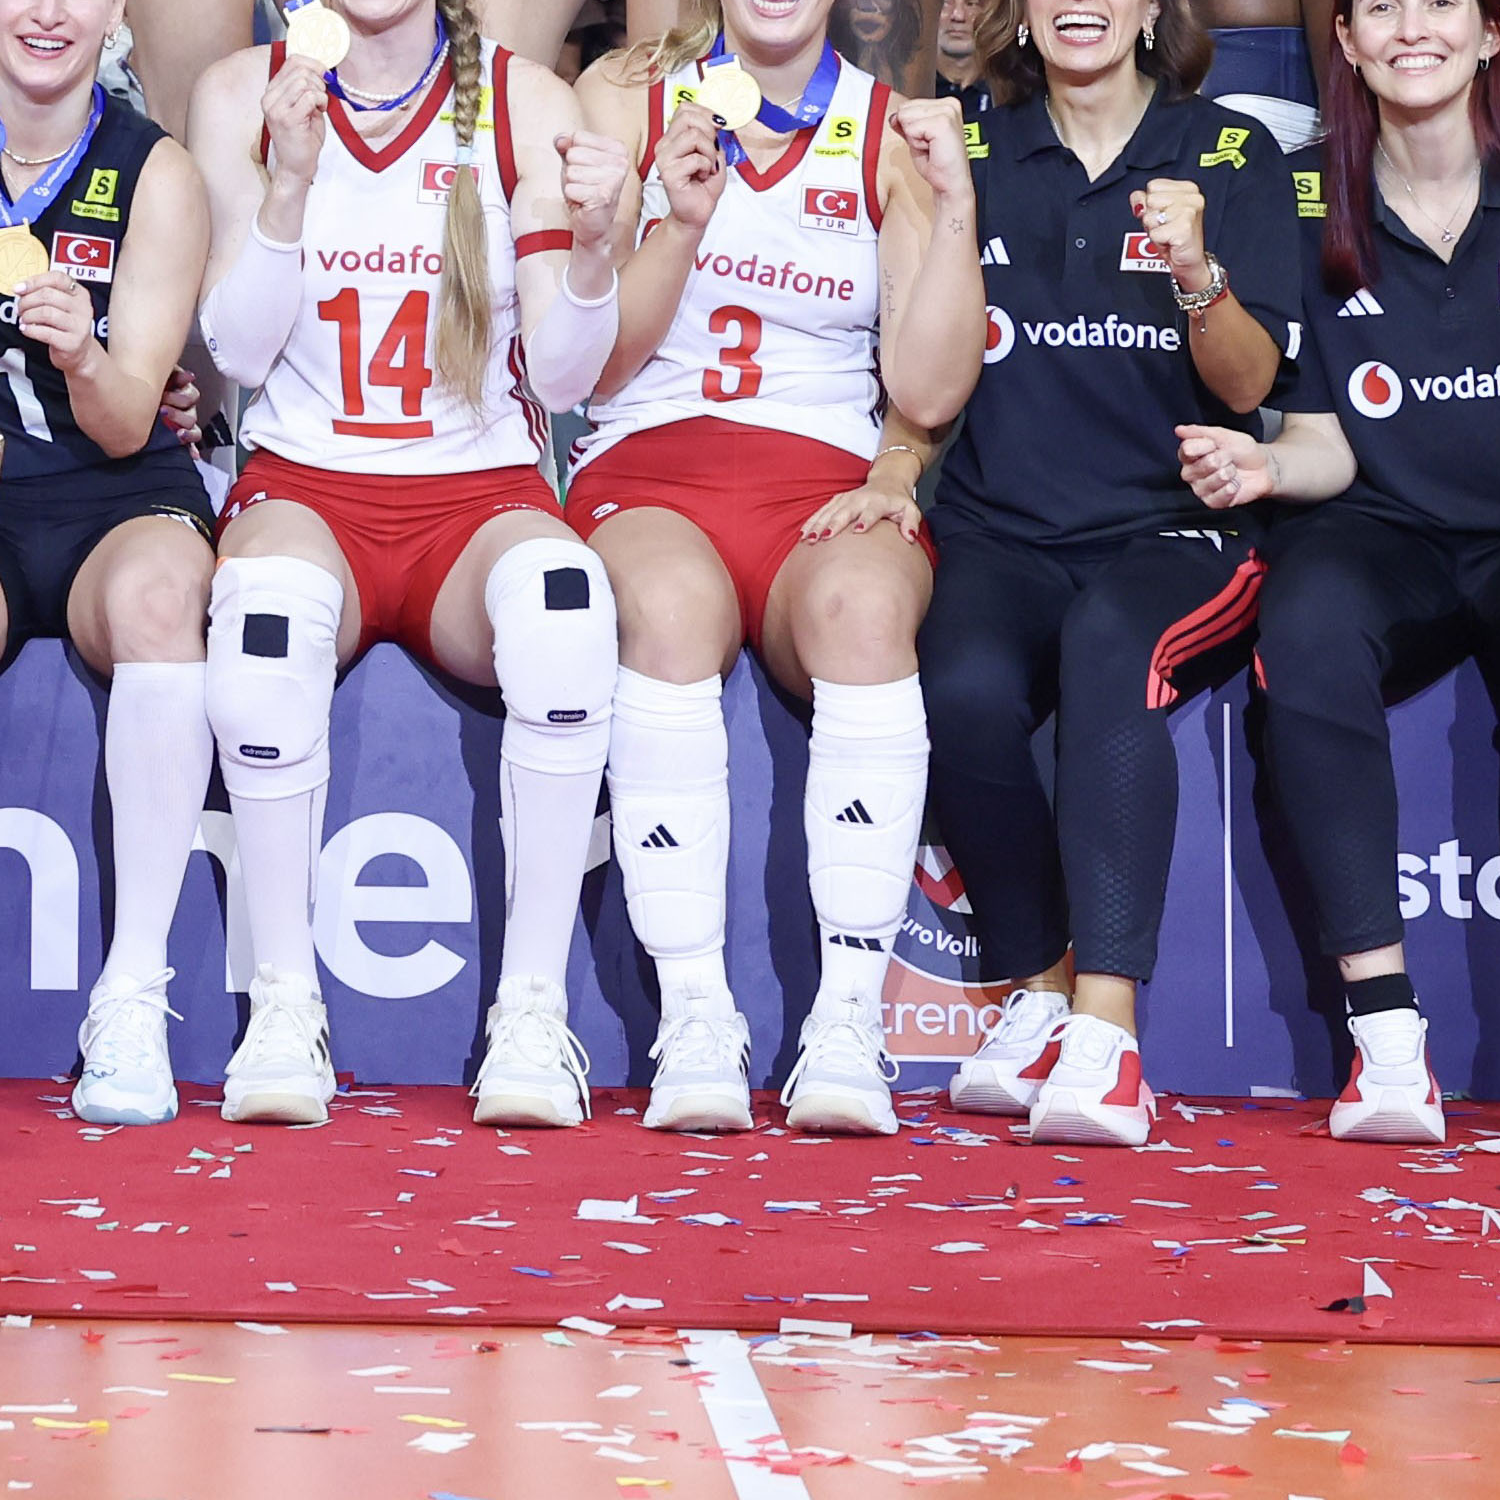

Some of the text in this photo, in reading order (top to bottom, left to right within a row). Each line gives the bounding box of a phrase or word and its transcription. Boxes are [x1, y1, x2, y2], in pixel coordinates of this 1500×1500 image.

[834, 120, 852, 140] S
[1225, 132, 1240, 147] S
[94, 174, 110, 197] S
[1297, 178, 1312, 196] S
[814, 215, 846, 230] TUR
[64, 264, 99, 277] TUR
[694, 251, 855, 301] vodafone
[1022, 313, 1183, 353] vodafone
[317, 287, 434, 417] 14
[700, 306, 763, 403] 3
